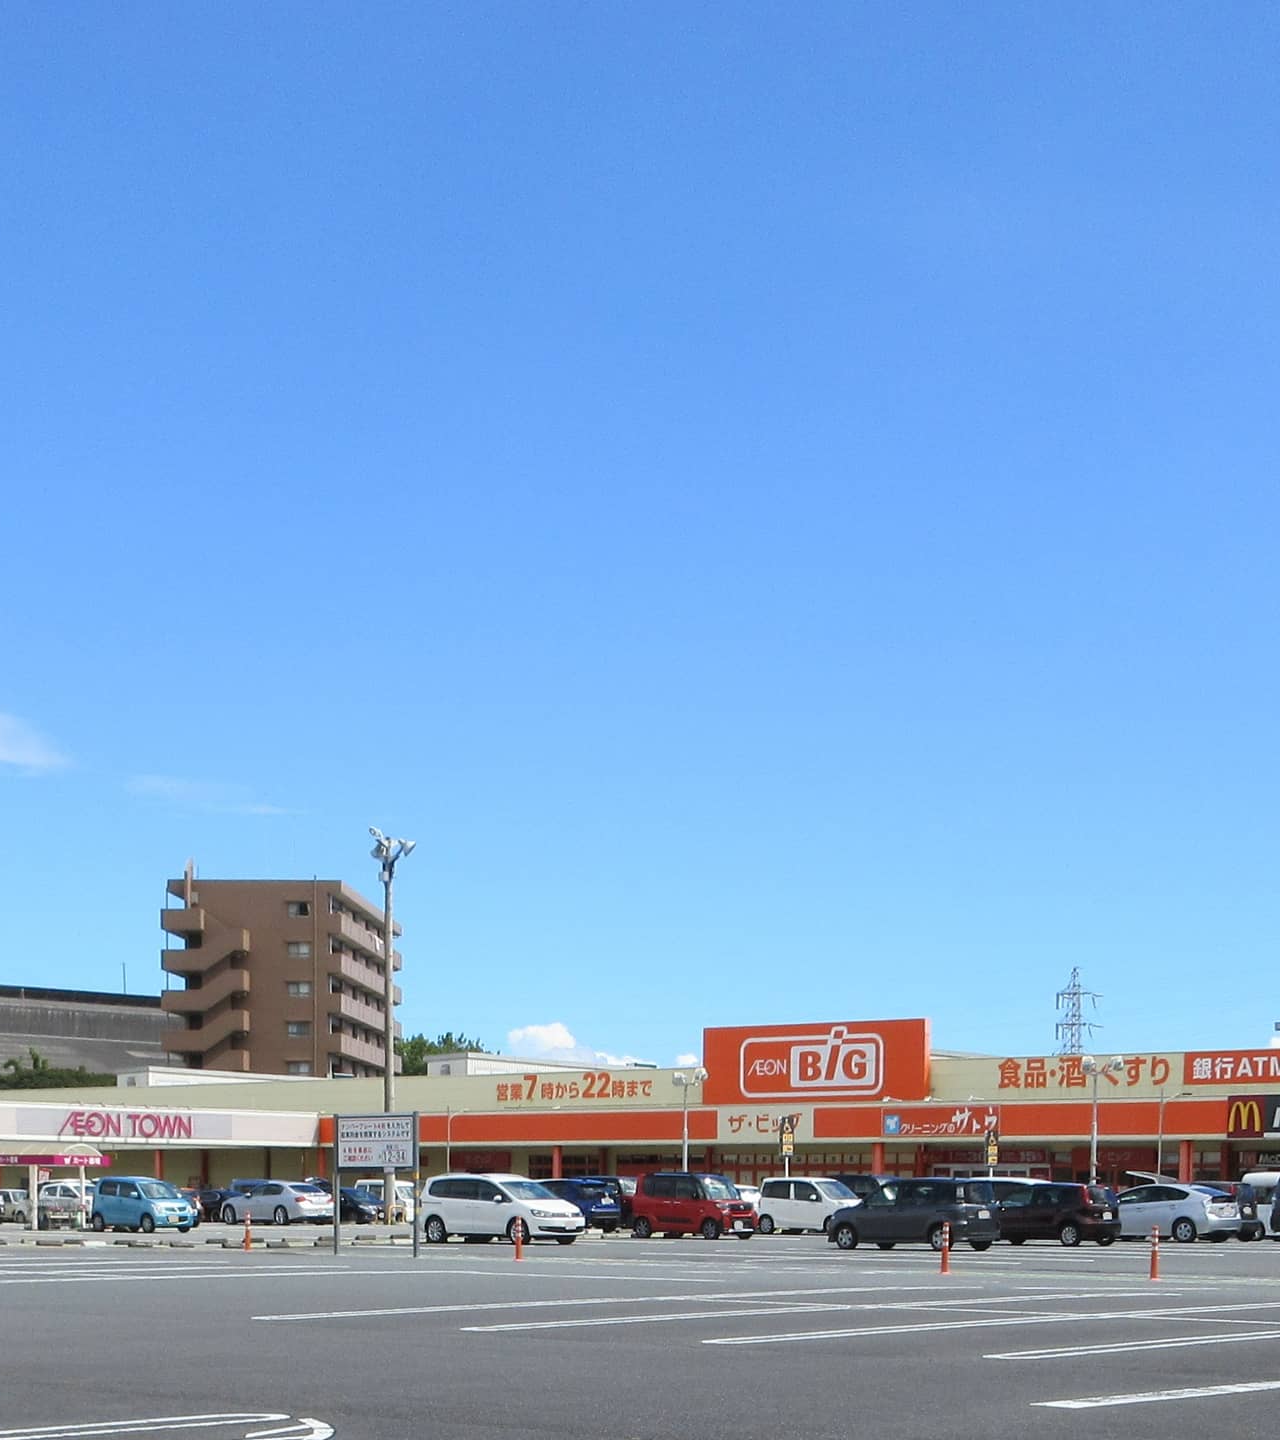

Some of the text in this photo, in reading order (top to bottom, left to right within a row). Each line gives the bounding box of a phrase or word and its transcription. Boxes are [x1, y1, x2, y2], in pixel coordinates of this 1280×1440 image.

[496, 1072, 653, 1101] 営業7時から22時まで
[998, 1056, 1171, 1088] 食品・酒くすり
[126, 1113, 193, 1138] TOWN
